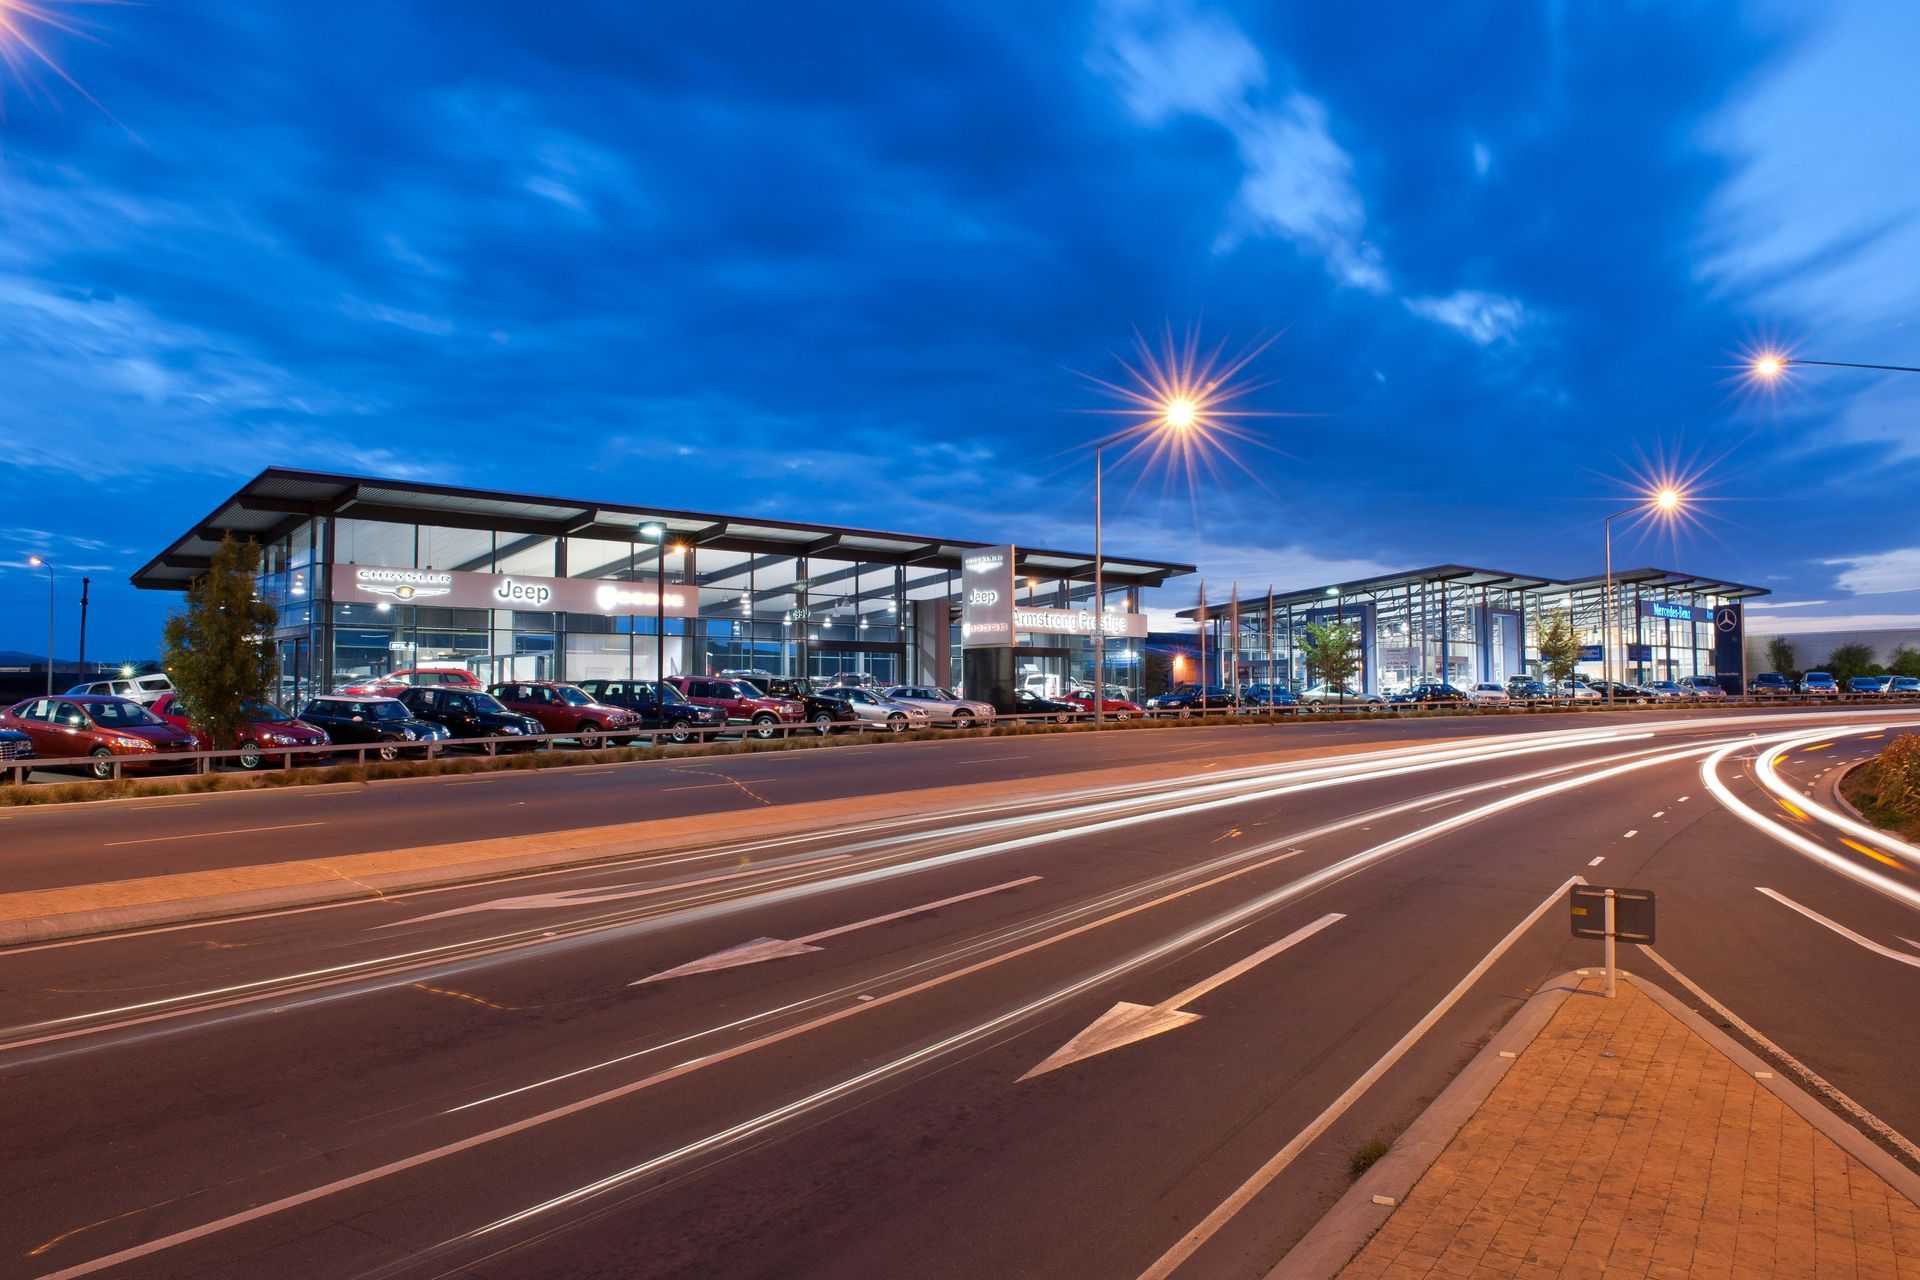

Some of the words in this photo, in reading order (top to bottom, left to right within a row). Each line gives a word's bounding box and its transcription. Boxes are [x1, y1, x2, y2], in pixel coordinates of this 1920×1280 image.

[358, 569, 452, 583] CHRYSLER
[497, 579, 550, 605] Jeep
[968, 589, 997, 605] Jeep
[1014, 608, 1078, 632] Armstrong
[1653, 602, 1692, 620] Mercedes-Benz
